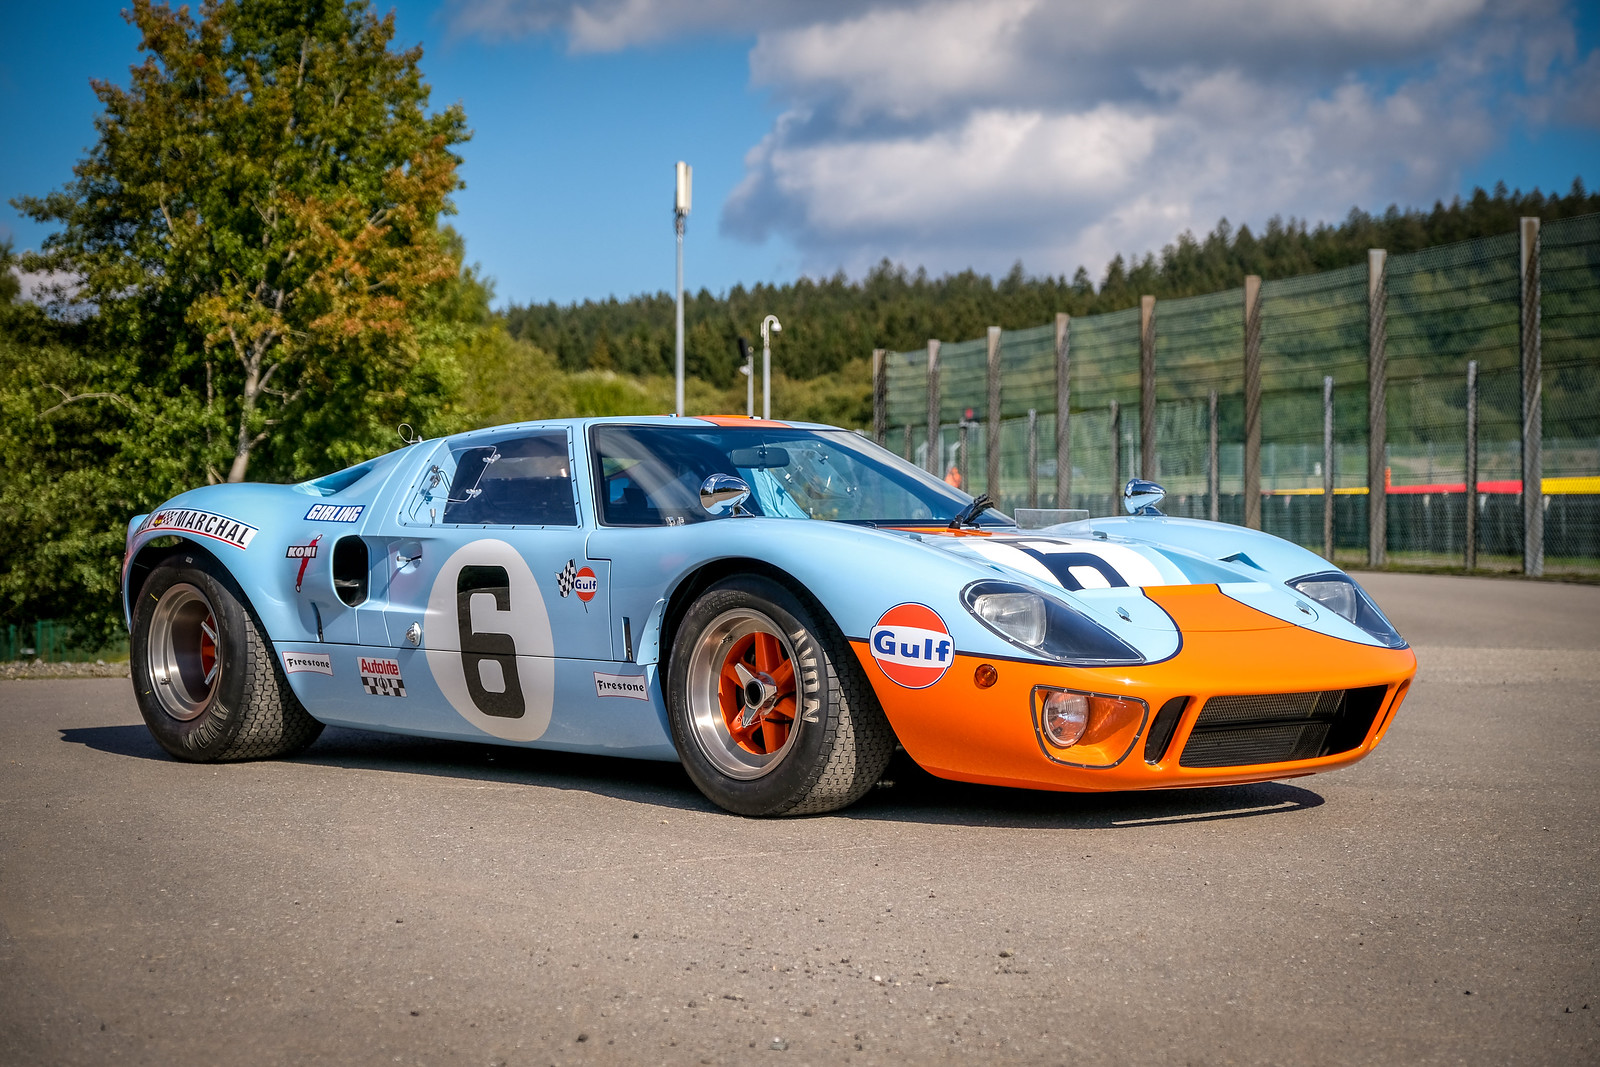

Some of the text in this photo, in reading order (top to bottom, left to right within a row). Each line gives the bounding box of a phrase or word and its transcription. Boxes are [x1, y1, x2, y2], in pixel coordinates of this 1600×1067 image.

[307, 504, 363, 522] GIRLING
[174, 510, 249, 544] MARCHAL
[288, 546, 317, 557] KONI
[575, 579, 597, 590] Gulf
[457, 565, 525, 719] 6
[873, 630, 951, 663] Gulf
[286, 658, 330, 668] Firestone
[361, 658, 399, 675] Autolite
[789, 628, 820, 724] AVON
[597, 680, 645, 691] Firestone
